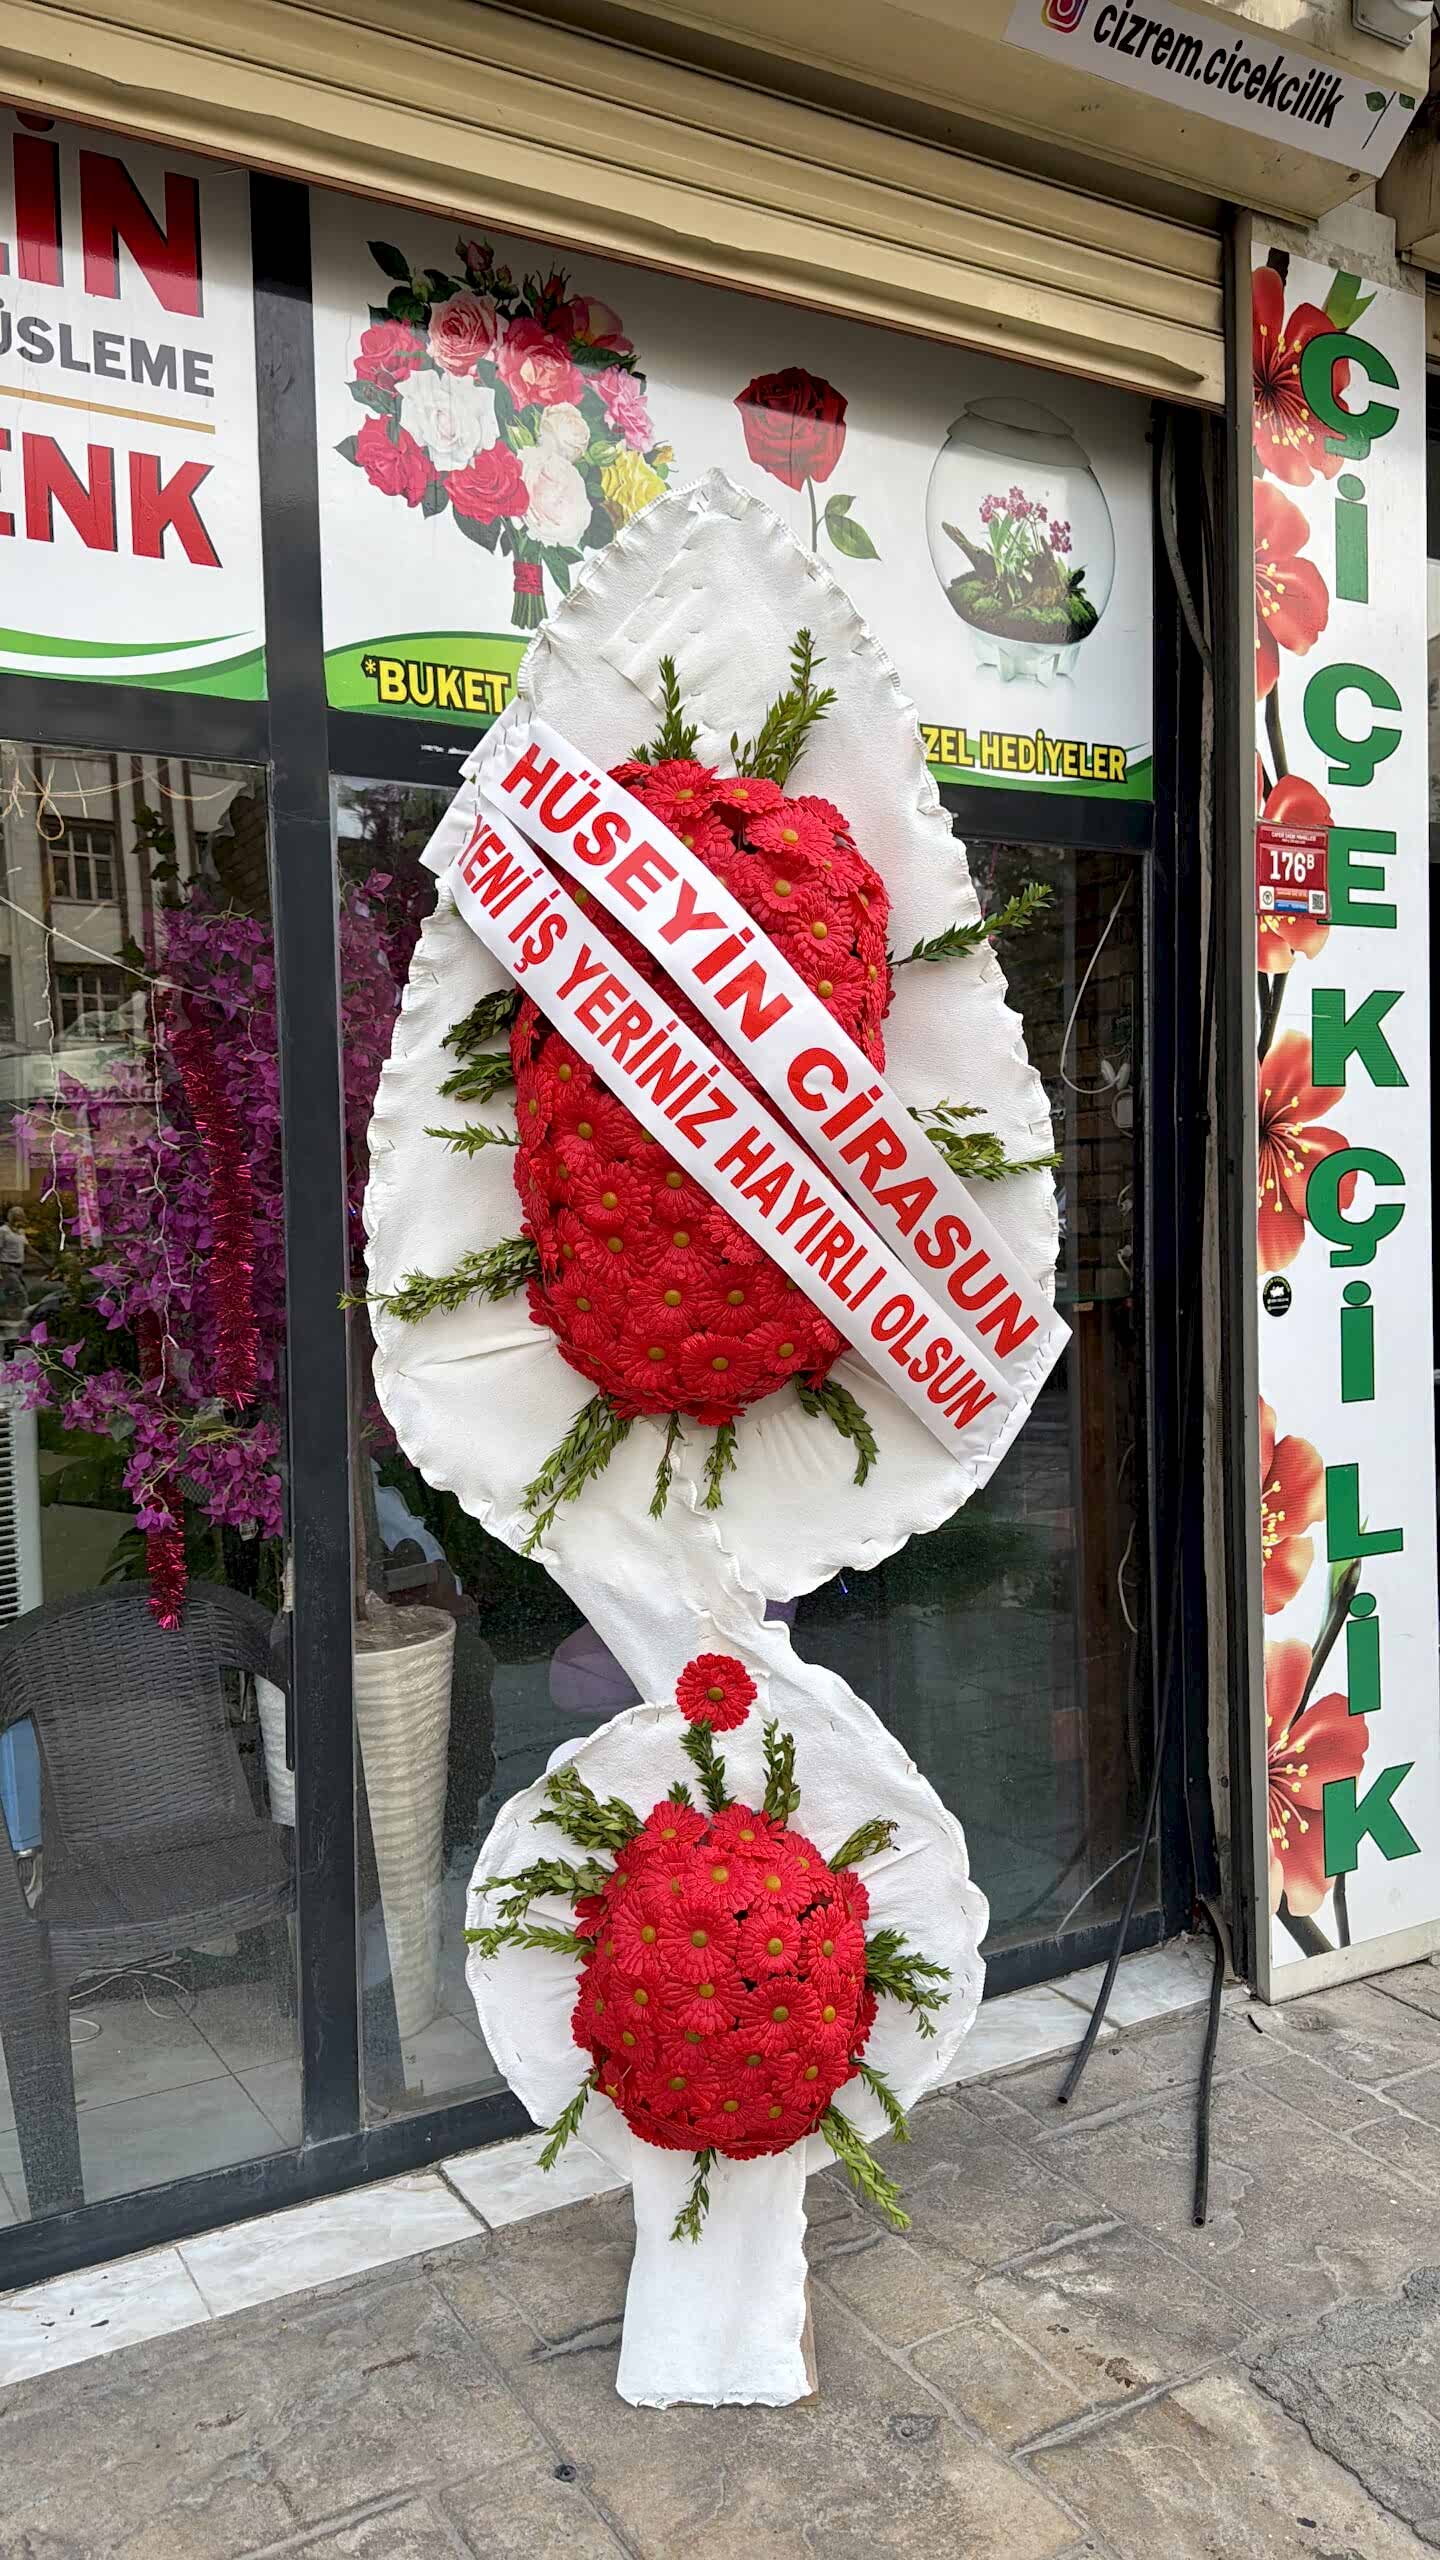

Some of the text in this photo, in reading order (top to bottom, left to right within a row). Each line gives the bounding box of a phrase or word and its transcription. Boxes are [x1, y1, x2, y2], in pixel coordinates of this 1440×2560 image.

[1093, 0, 1344, 129] cizrem.cicekcilik
[0, 111, 204, 318] İN
[0, 428, 223, 569] NK
[979, 729, 1127, 783] HEDİYELER
[457, 814, 997, 1430] YENİ İŞ YERİNİZ HAYIRLI OLSUN
[501, 743, 1039, 1358] HÜSEYİN CİRASUN
